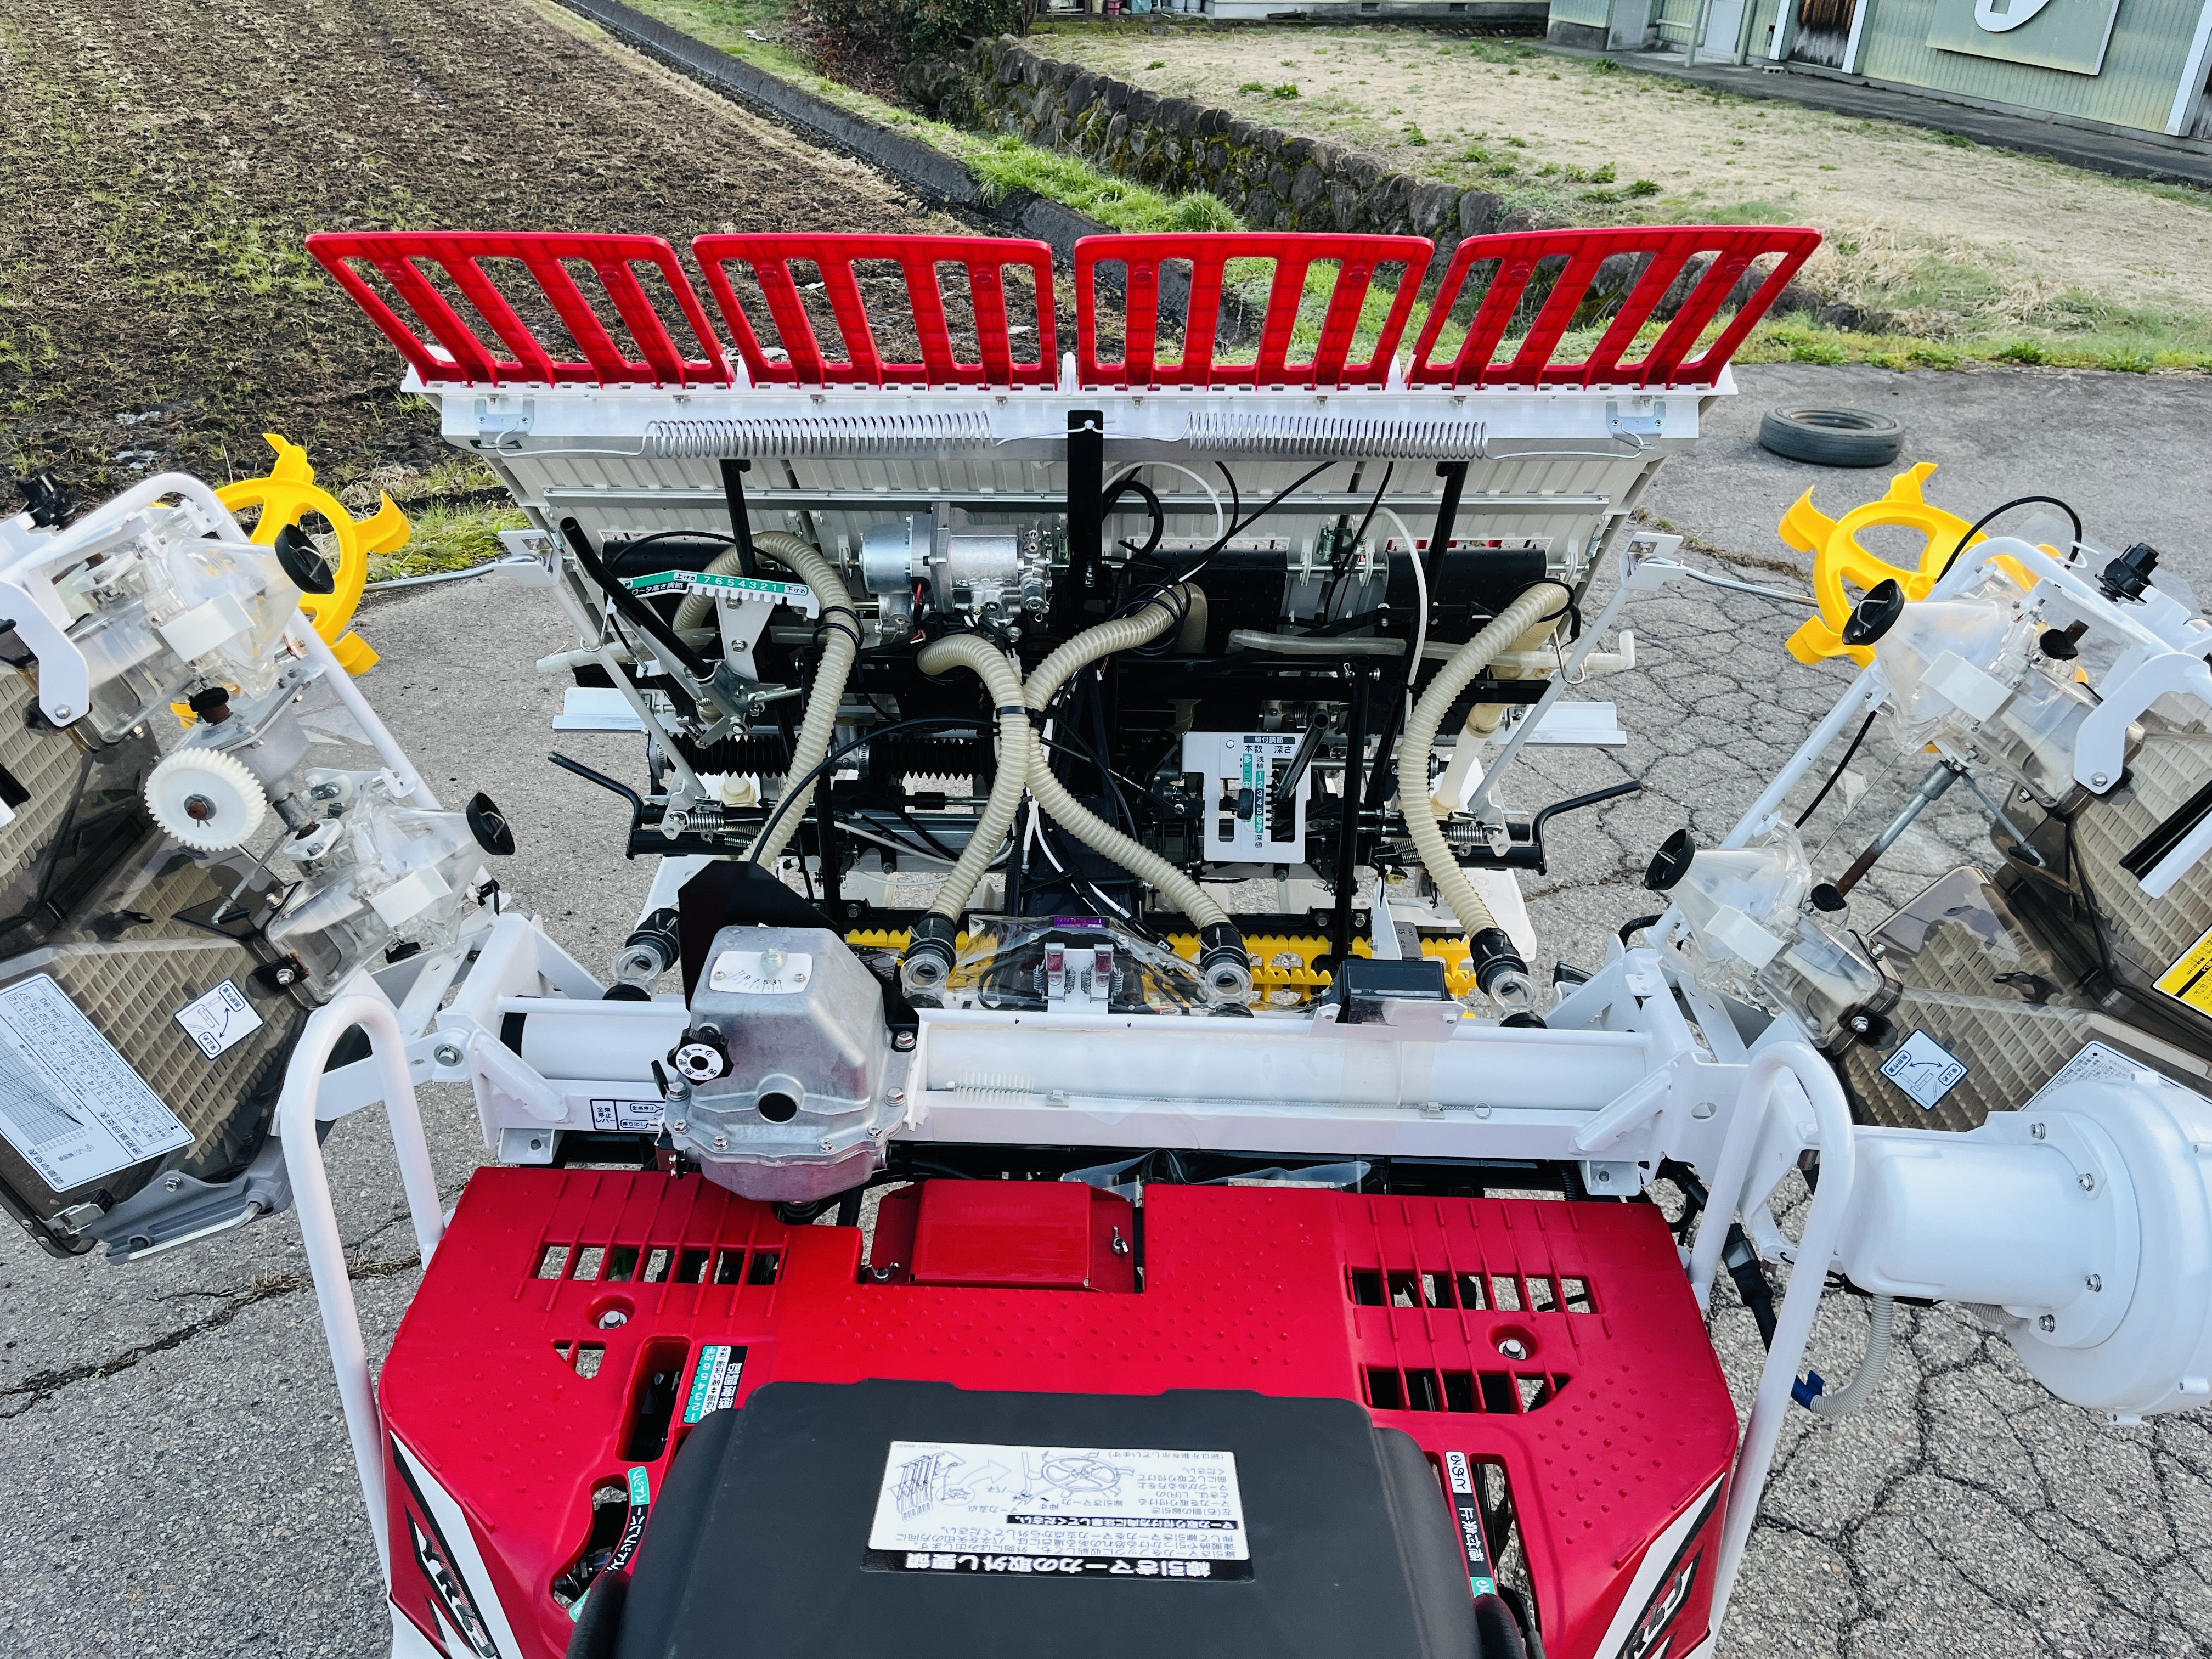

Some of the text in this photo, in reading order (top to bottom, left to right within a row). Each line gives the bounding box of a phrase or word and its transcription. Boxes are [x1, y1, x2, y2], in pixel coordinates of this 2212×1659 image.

[703, 575, 711, 584] 7
[749, 581, 757, 589] 3
[631, 582, 684, 595] ロータ高さ調節
[1244, 744, 1263, 754] 本数
[1274, 745, 1292, 754] 深さ
[1243, 755, 1251, 764] 多
[7, 995, 21, 1006] 12
[38, 997, 52, 1008] 90
[18, 1006, 30, 1016] 11
[47, 1008, 61, 1019] 84
[27, 1016, 40, 1026] 10
[57, 1018, 71, 1029] 77
[67, 1029, 80, 1039] 71
[76, 1039, 90, 1049] 64
[18, 991, 135, 1114] 10 12 15 17 20 22 25 27 30 32 35 37
[86, 1049, 99, 1060] 58
[95, 1060, 109, 1070] 52
[105, 1070, 118, 1080] 45
[114, 1080, 127, 1090] 39
[123, 1090, 136, 1100] 32
[132, 1100, 146, 1110] 26
[98, 1110, 143, 1155] 施肥量目安表
[703, 1362, 712, 1370] 6
[700, 1372, 709, 1381] 5
[697, 1382, 706, 1390] 4
[717, 1363, 742, 1410] 感度調節
[693, 1391, 704, 1400] 3
[691, 1402, 701, 1411] 2
[690, 1413, 696, 1421] 1
[1181, 1466, 1225, 1475] ください。
[1449, 1455, 1465, 1489] とめる
[1136, 1474, 1226, 1483] 側にして取り付けて
[1136, 1481, 1228, 1492] マークがある方を上
[1039, 1502, 1059, 1510] 押す
[1062, 1497, 1123, 1508] 線引きマーカ
[1137, 1498, 1231, 1508] マーカを取り付ける
[967, 1504, 1019, 1514] マーカ支点
[605, 1506, 644, 1572] ストップレバー
[1458, 1507, 1485, 1562] 植付条止
[904, 1550, 1211, 1578] 線引きマーカの取外し要領
[422, 1534, 498, 1658] YR4J
